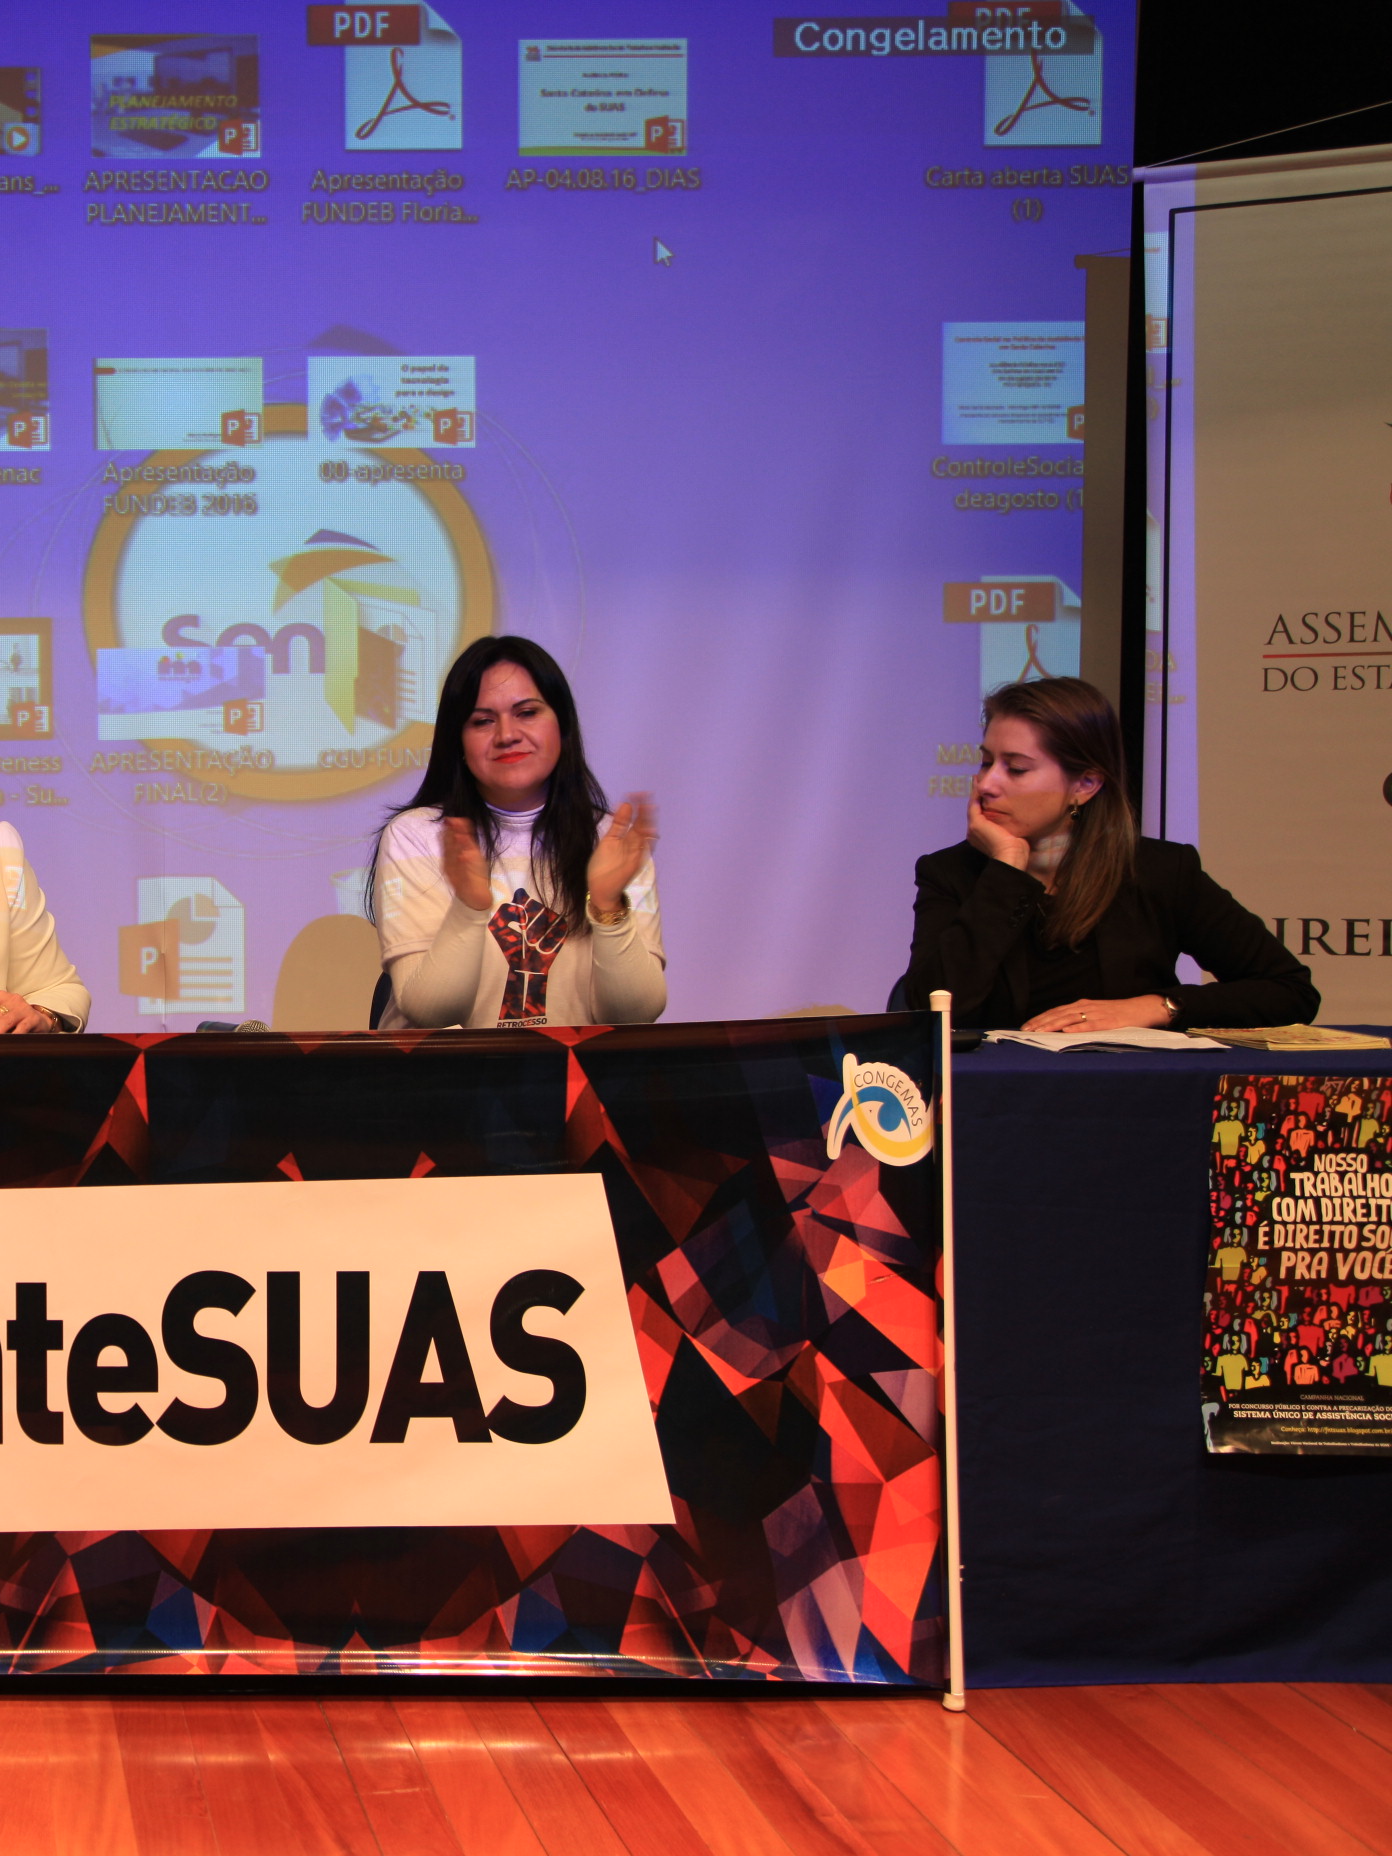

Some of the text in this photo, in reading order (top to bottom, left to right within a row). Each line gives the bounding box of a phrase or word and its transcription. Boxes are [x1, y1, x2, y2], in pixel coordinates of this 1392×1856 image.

[333, 12, 390, 38] PDF
[795, 20, 1067, 56] Congelamento
[110, 95, 238, 109] PLANEJAMENTO
[110, 113, 217, 130] ESTRATÉGICO
[84, 170, 270, 192] APRESENTACAO
[311, 169, 465, 195] Apresentação
[506, 168, 702, 193] AP-04.08.16_DIAS
[925, 164, 1130, 188] Carta aberta SUAS
[86, 203, 268, 225] PLANEJAMENT...
[301, 202, 395, 224] FUNDEB
[1012, 199, 1043, 223] (1)
[102, 461, 256, 488] Apresentação
[932, 455, 1084, 478] ControleSocia
[102, 494, 259, 515] FUNDEB 2016
[955, 489, 1059, 513] deagosto
[970, 589, 1025, 615] PDF
[1263, 664, 1392, 692] DO EST
[90, 747, 276, 776] APRESENTAÇÃO
[141, 946, 160, 975] P
[497, 1018, 547, 1028] RETROCESSO
[854, 1071, 922, 1126] CONGEMAS
[1313, 1153, 1368, 1173] NOSSO
[1290, 1172, 1392, 1197] TRABALHO
[1272, 1197, 1392, 1223] COM DIREIT
[1257, 1220, 1392, 1250] É DIREITO SO
[1279, 1250, 1328, 1280] PRA
[1233, 1410, 1271, 1418] SISTEMA
[1273, 1409, 1300, 1419] ÚNICO
[1315, 1411, 1372, 1420] ASSISTÊNCIA
